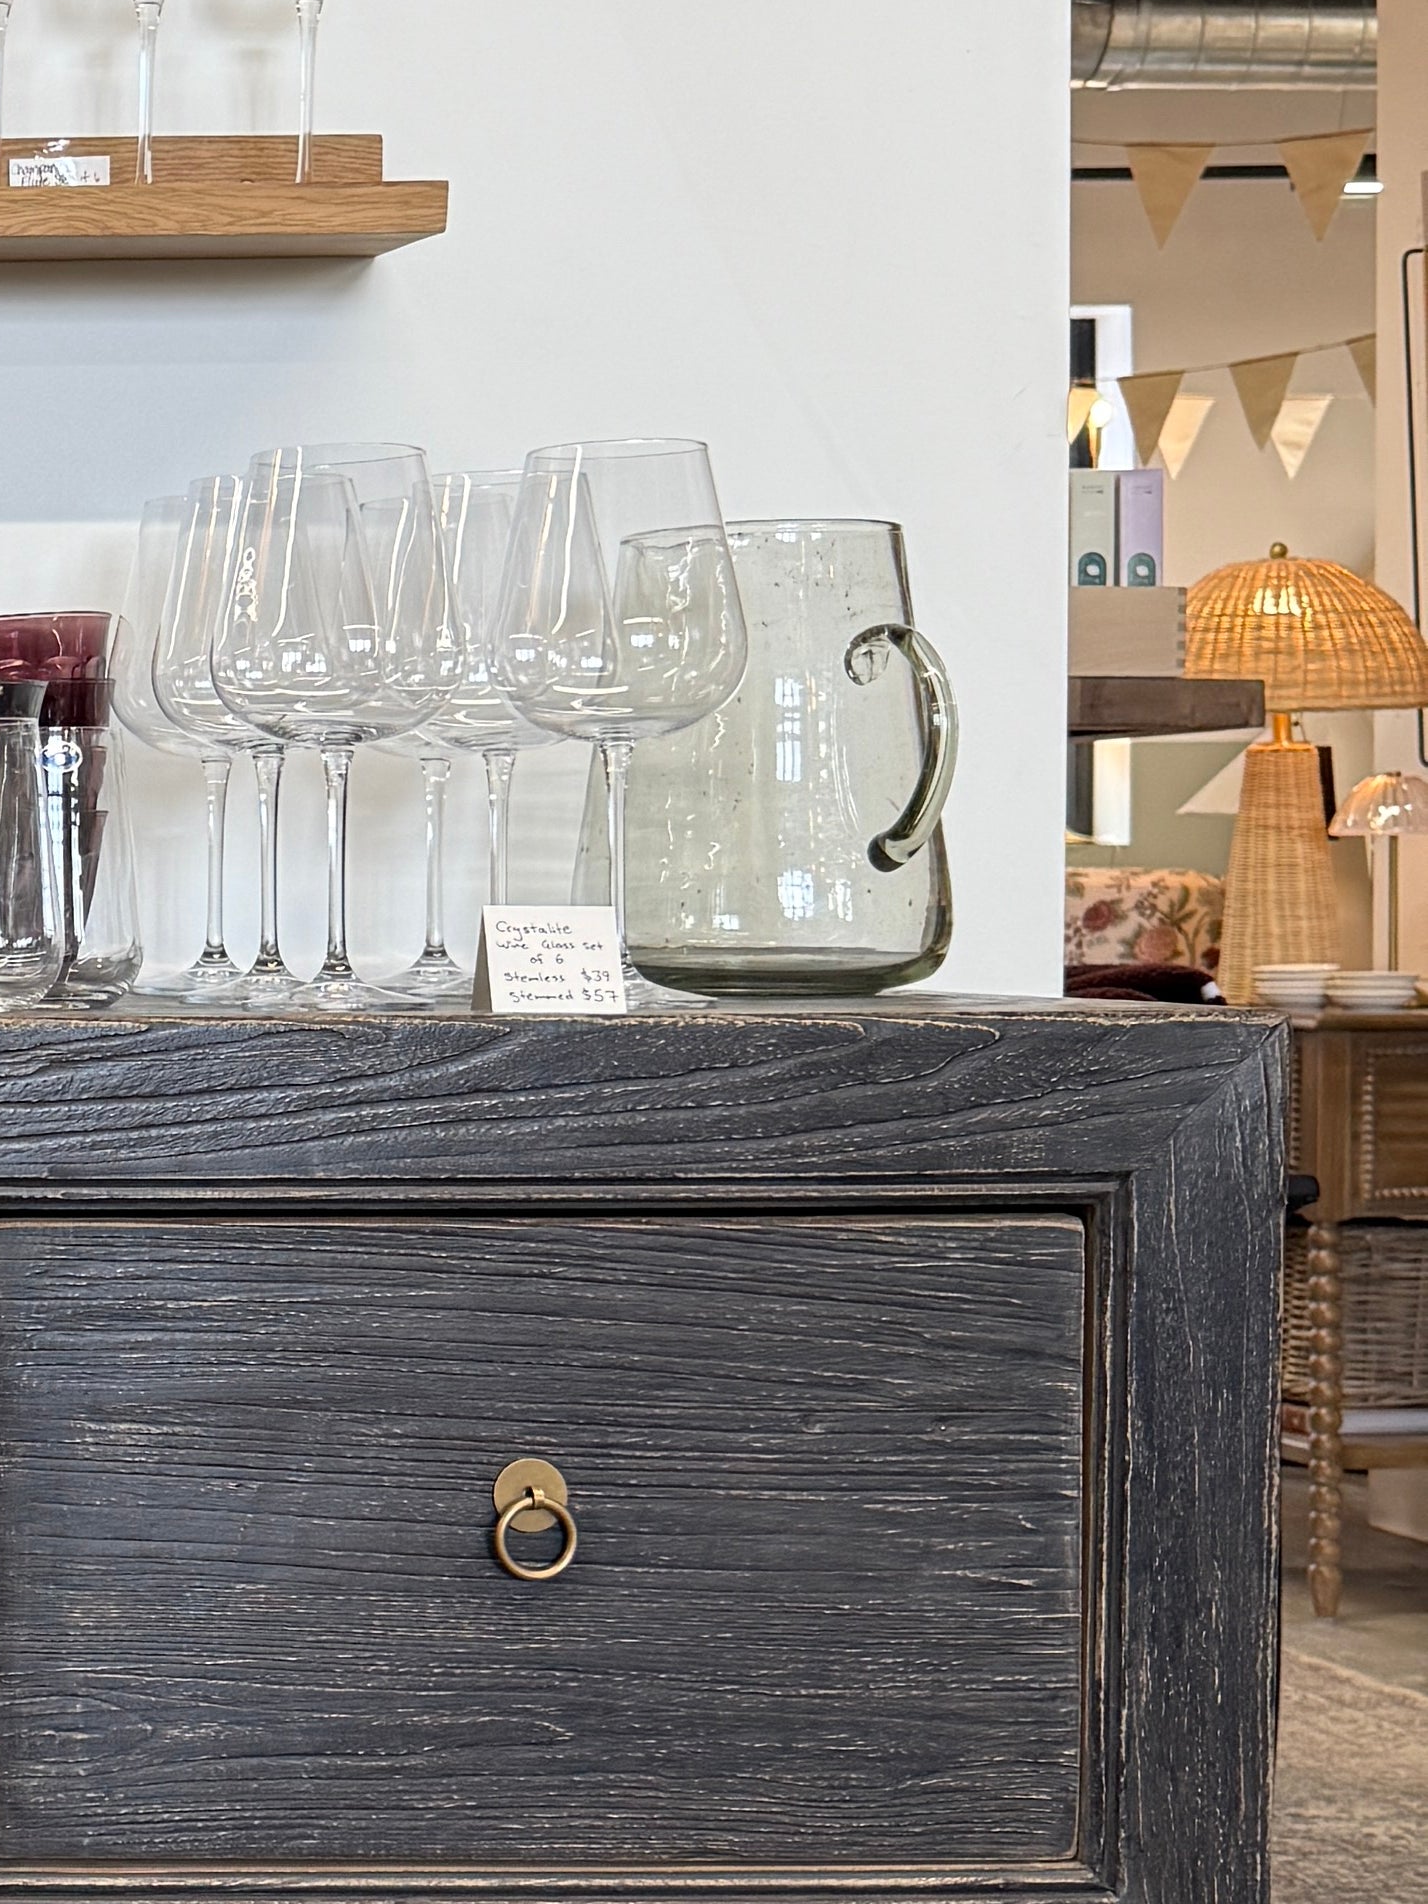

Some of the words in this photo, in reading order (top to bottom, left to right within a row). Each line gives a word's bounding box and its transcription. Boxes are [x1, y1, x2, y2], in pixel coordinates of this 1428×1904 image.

[495, 920, 573, 942] Crystalite
[529, 953, 544, 965] of
[555, 953, 565, 965] 6
[580, 967, 610, 984] $39
[581, 987, 620, 1003] $57
